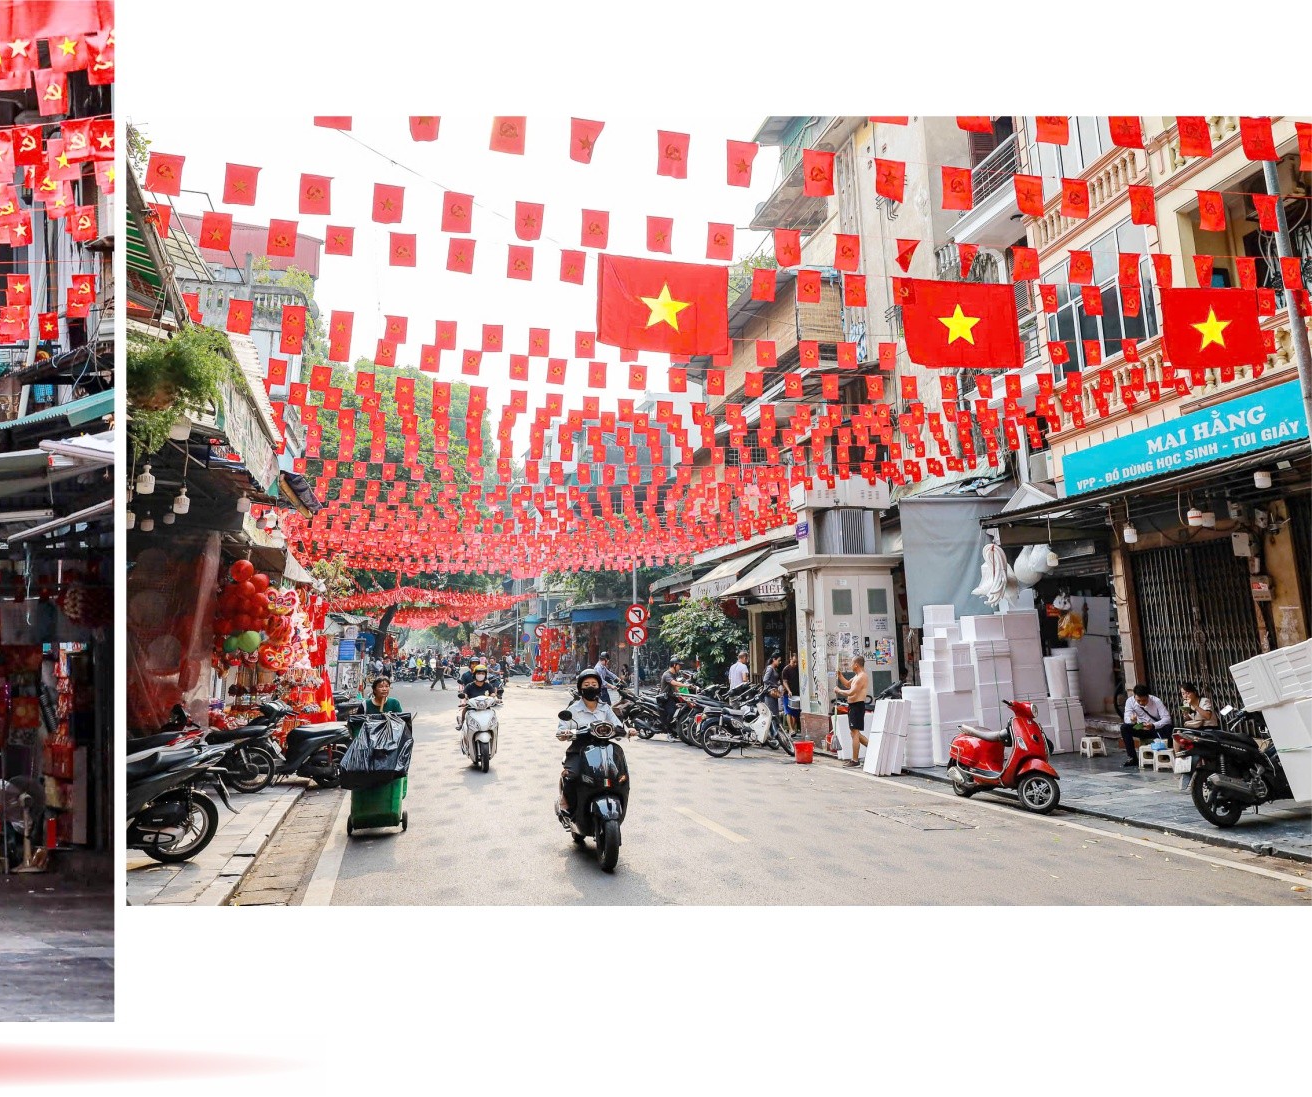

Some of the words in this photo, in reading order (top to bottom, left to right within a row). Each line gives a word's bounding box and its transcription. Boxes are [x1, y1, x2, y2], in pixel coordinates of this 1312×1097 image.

[1077, 477, 1096, 491] VPP
[1122, 459, 1154, 478] DÙNG
[1156, 454, 1182, 470] HỌC
[1185, 443, 1218, 460] SINH
[1232, 431, 1257, 449] TÚI
[1260, 418, 1300, 442] GIẤY
[1146, 428, 1187, 455] MAI
[1192, 406, 1266, 441] HẰNG
